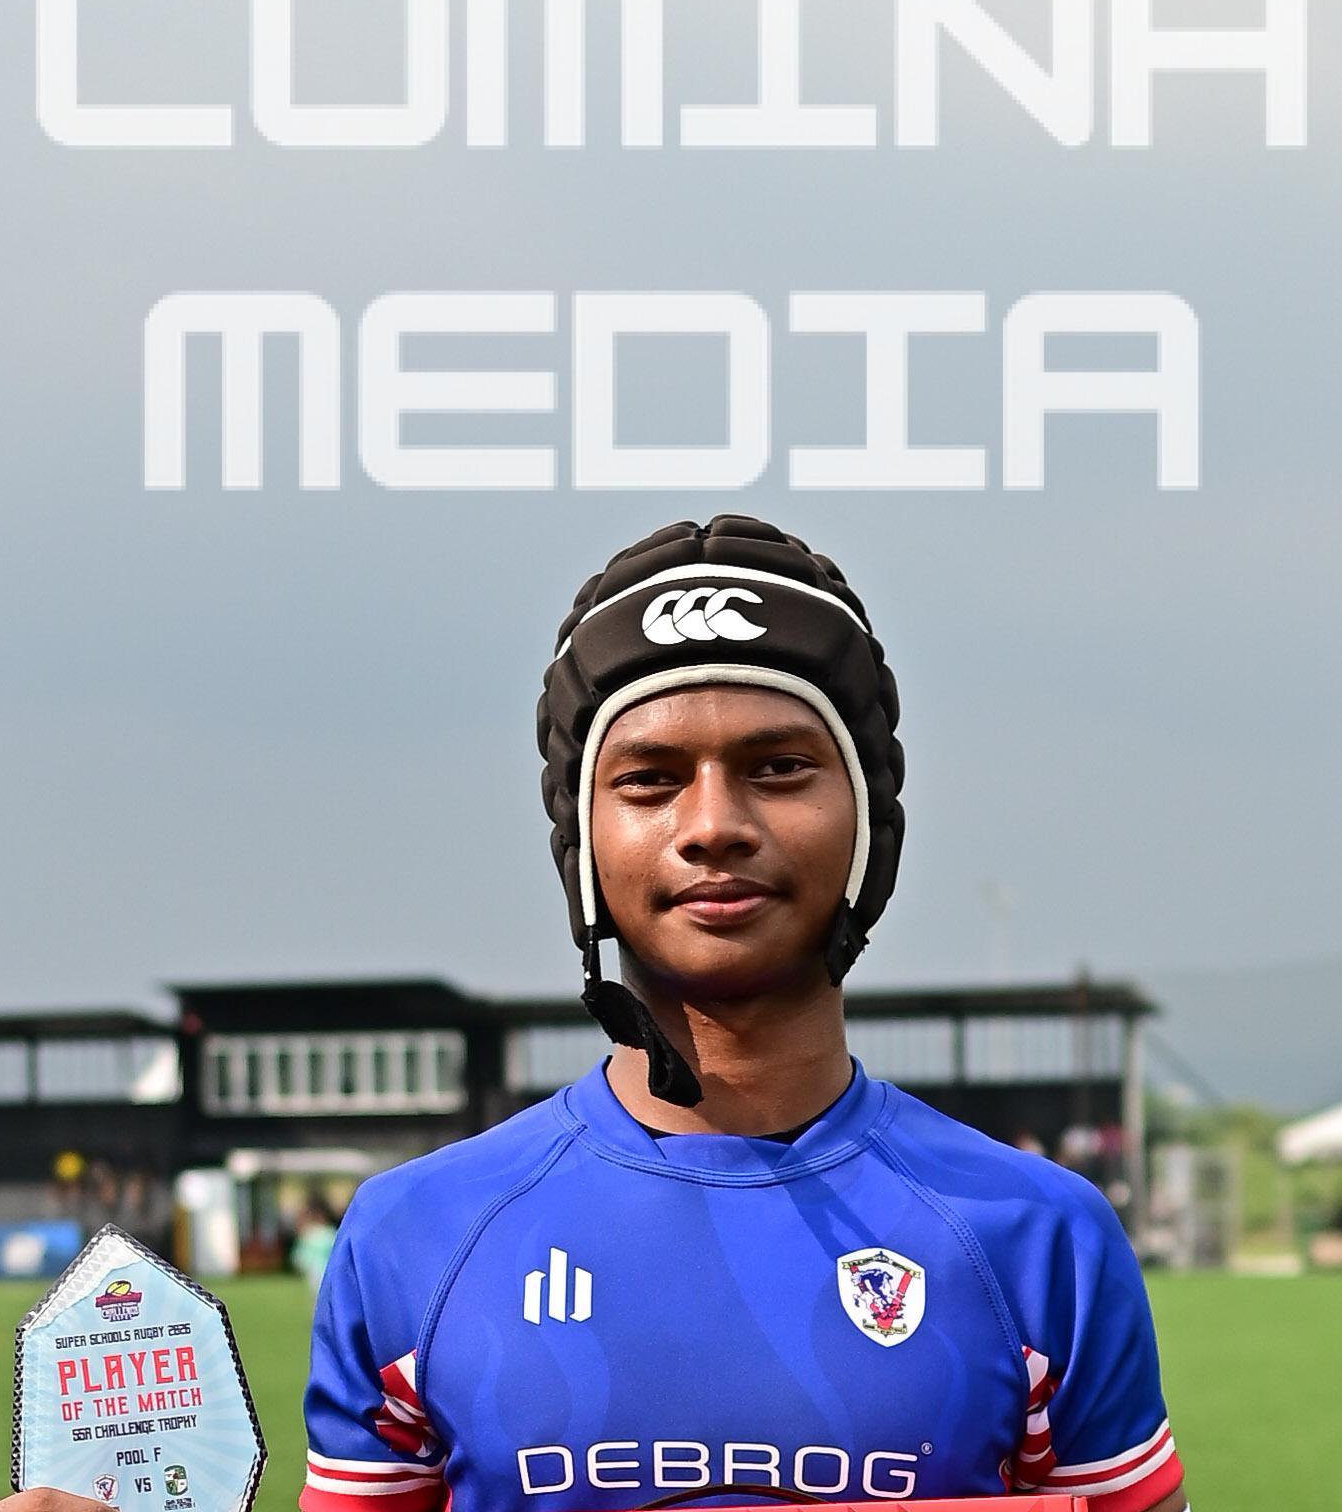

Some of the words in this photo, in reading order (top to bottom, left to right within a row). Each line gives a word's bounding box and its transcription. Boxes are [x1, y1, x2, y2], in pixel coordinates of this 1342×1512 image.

[55, 1335, 87, 1349] SUPER
[89, 1329, 131, 1346] SCHOOLS
[56, 1346, 198, 1396] PLAYER
[61, 1401, 84, 1422] OF
[92, 1396, 130, 1418] THE
[137, 1387, 203, 1413] MATCH
[95, 1419, 156, 1439] CHALLENGE
[158, 1414, 198, 1432] TROPHY
[116, 1448, 149, 1467] POOL
[153, 1447, 162, 1462] F
[134, 1477, 152, 1493] VS
